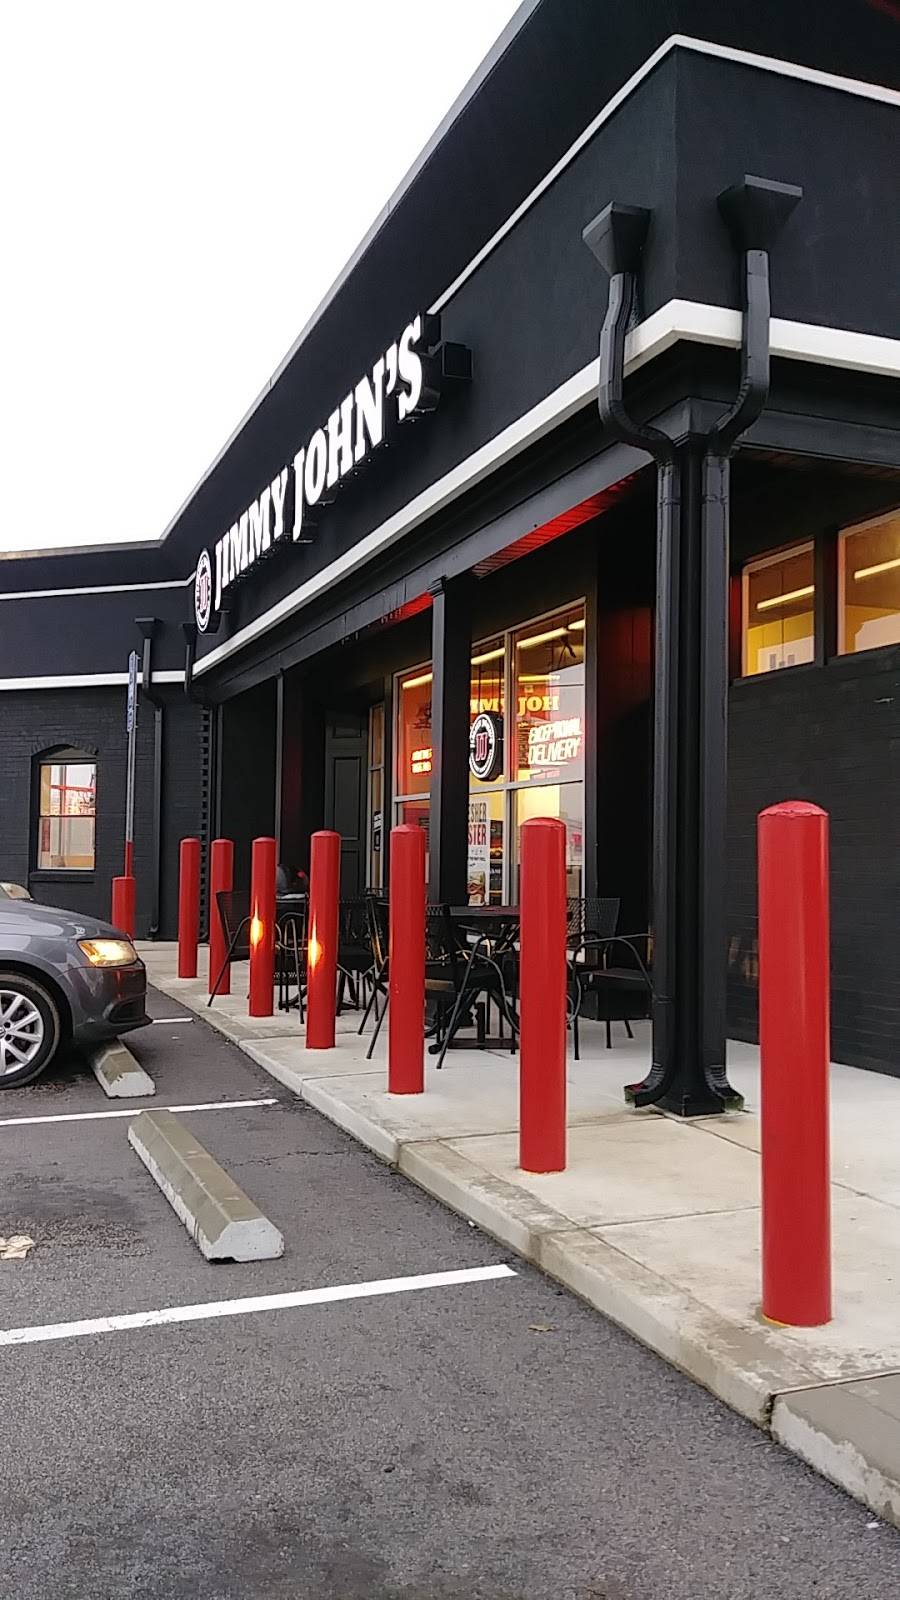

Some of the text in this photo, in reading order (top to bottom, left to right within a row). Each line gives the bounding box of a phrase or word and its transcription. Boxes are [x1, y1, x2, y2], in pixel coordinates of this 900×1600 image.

[214, 313, 422, 611] JIMMY JOHN'S
[528, 736, 581, 765] DELIVERY
